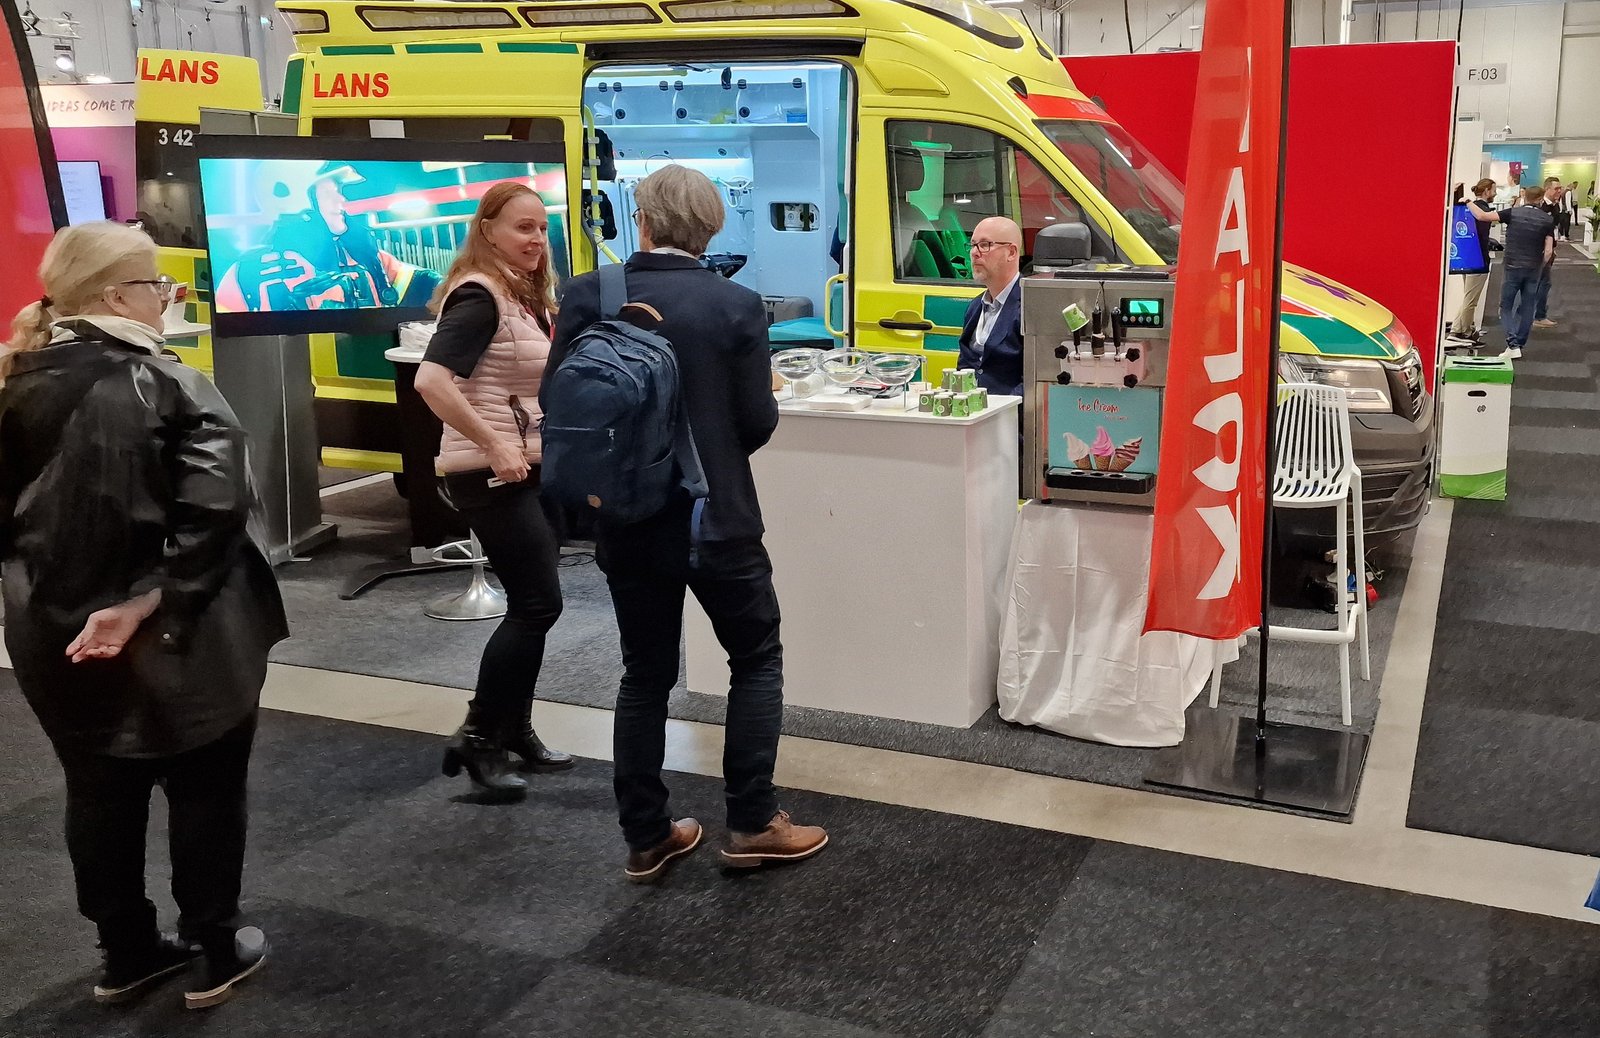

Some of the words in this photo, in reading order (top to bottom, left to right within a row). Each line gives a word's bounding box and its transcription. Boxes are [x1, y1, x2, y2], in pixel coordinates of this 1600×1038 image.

[135, 57, 219, 85] LANS
[1468, 68, 1498, 81] F:03
[314, 73, 389, 98] LANS
[47, 101, 79, 112] IDEAS
[84, 100, 117, 111] COME
[158, 128, 169, 145] 3
[1077, 398, 1092, 412] Ice
[1093, 399, 1121, 413] Cream
